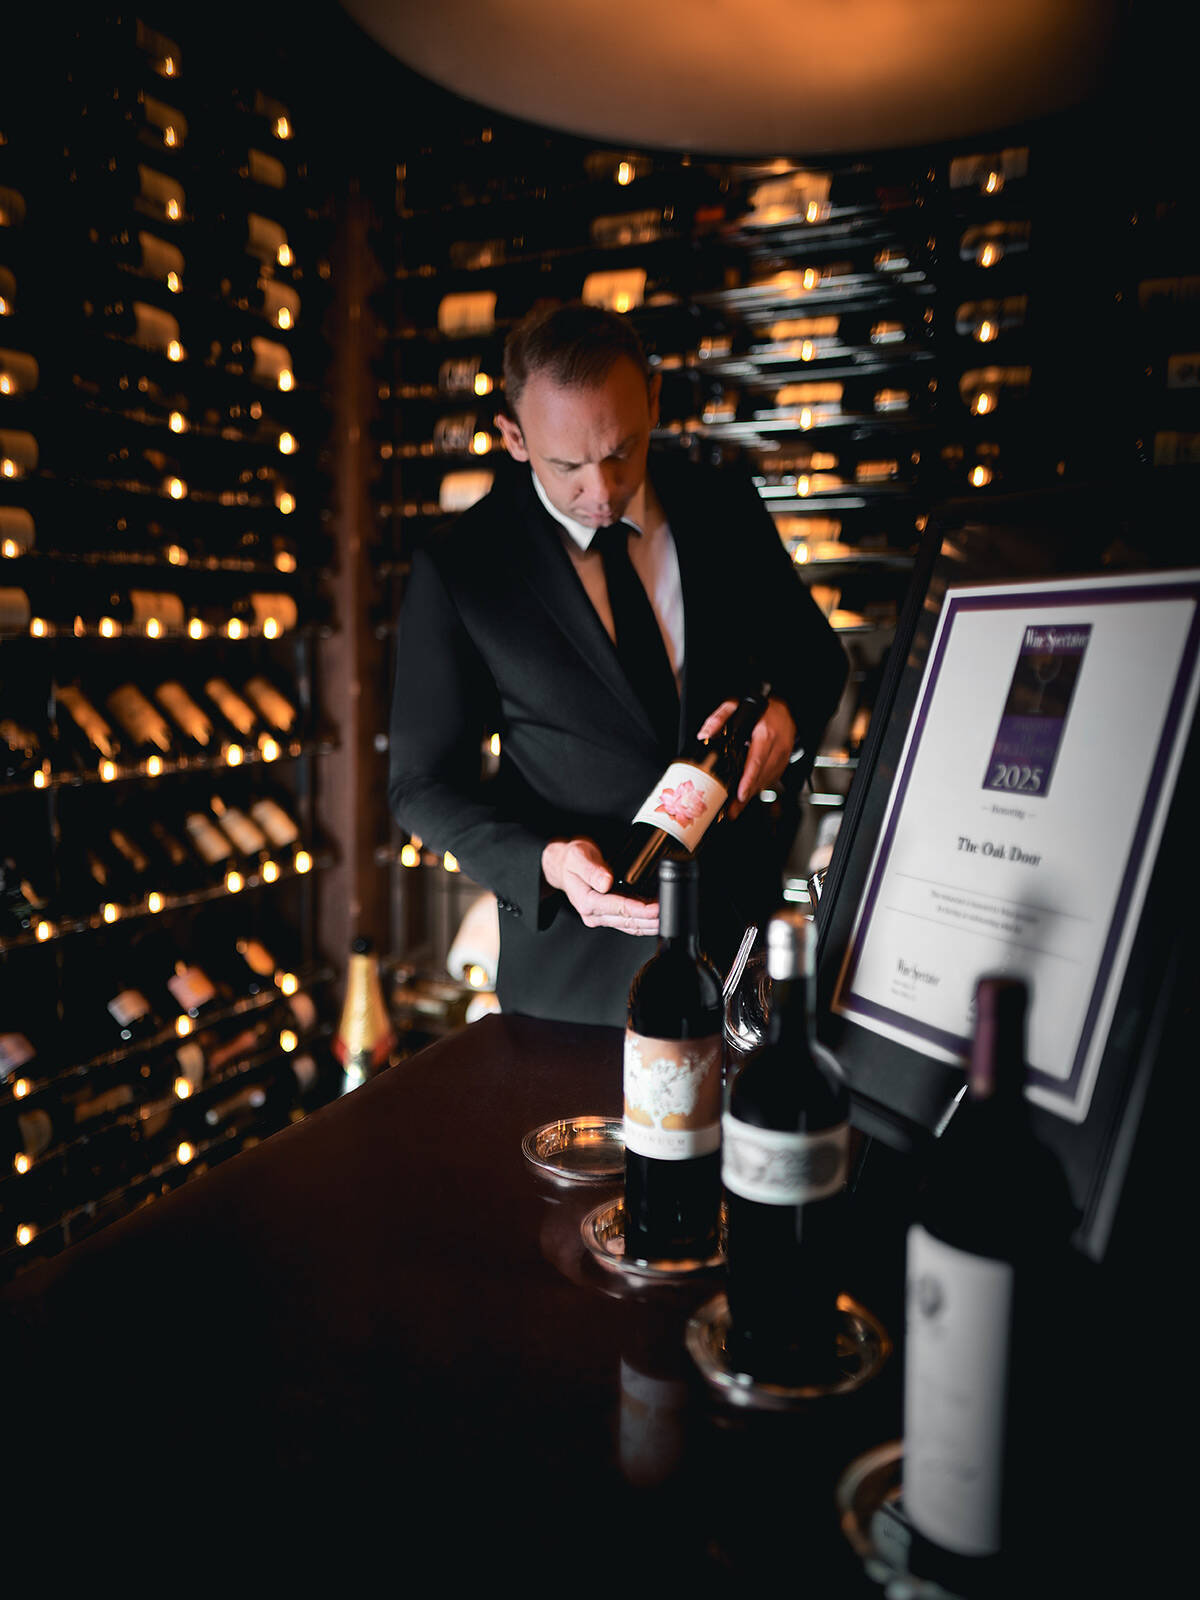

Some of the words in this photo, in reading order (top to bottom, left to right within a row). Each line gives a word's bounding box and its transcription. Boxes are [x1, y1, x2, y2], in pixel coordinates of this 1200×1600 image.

[992, 764, 1044, 792] 2025
[958, 836, 977, 854] The
[982, 841, 1005, 859] Oak
[1008, 846, 1042, 866] Door
